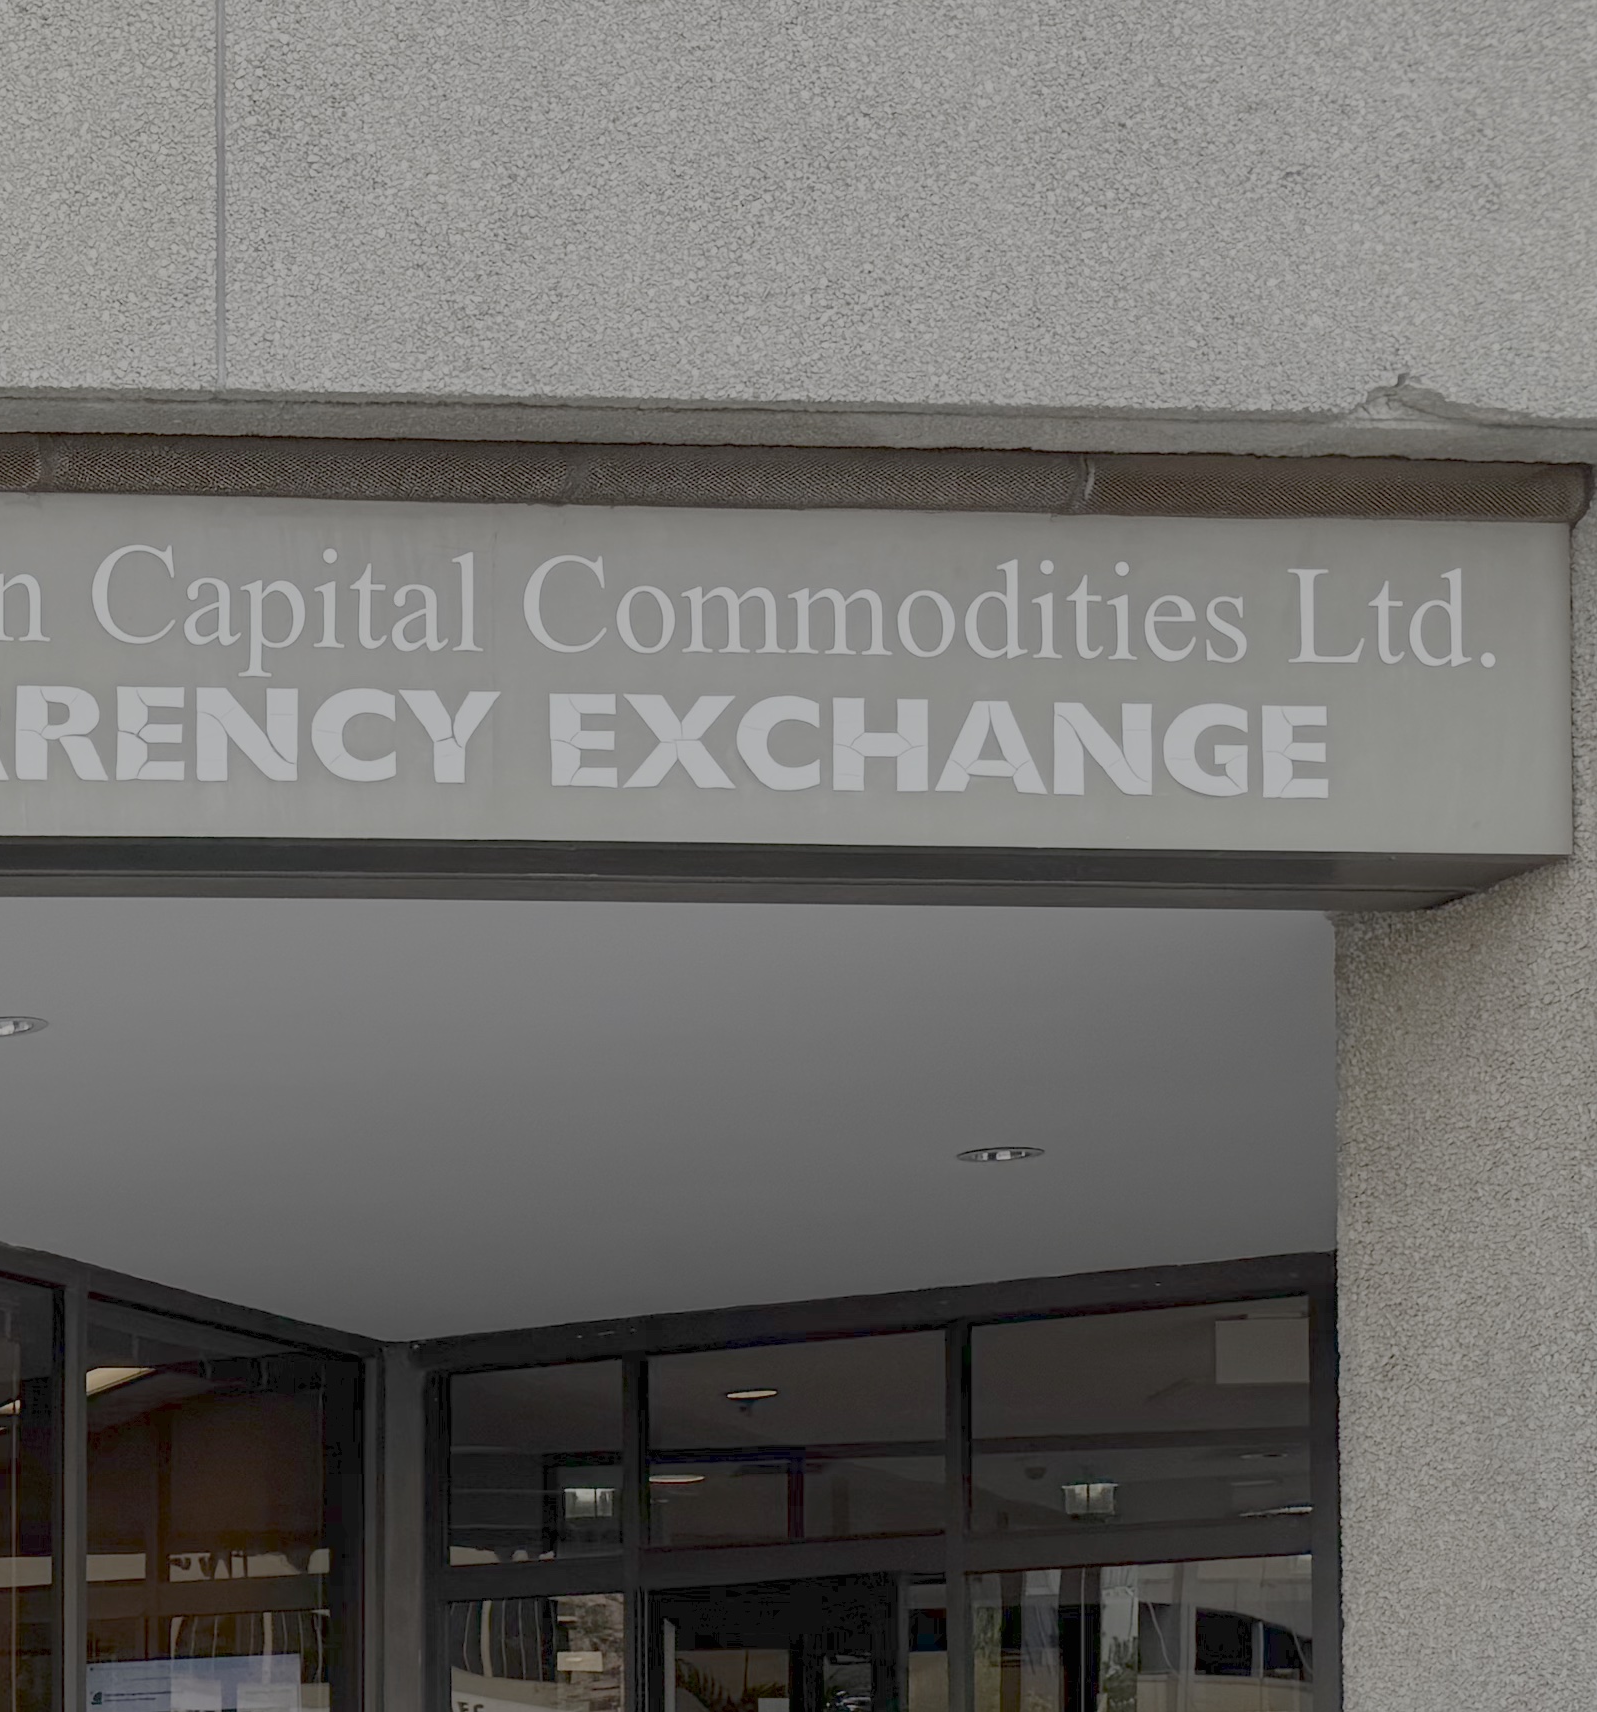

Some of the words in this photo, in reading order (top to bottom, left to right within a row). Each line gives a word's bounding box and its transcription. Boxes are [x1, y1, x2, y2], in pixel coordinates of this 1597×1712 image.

[89, 542, 486, 680] Capital
[520, 552, 1250, 667] Commodities
[1287, 564, 1499, 670] Ltd.
[548, 691, 1332, 804] EXCHANGE
